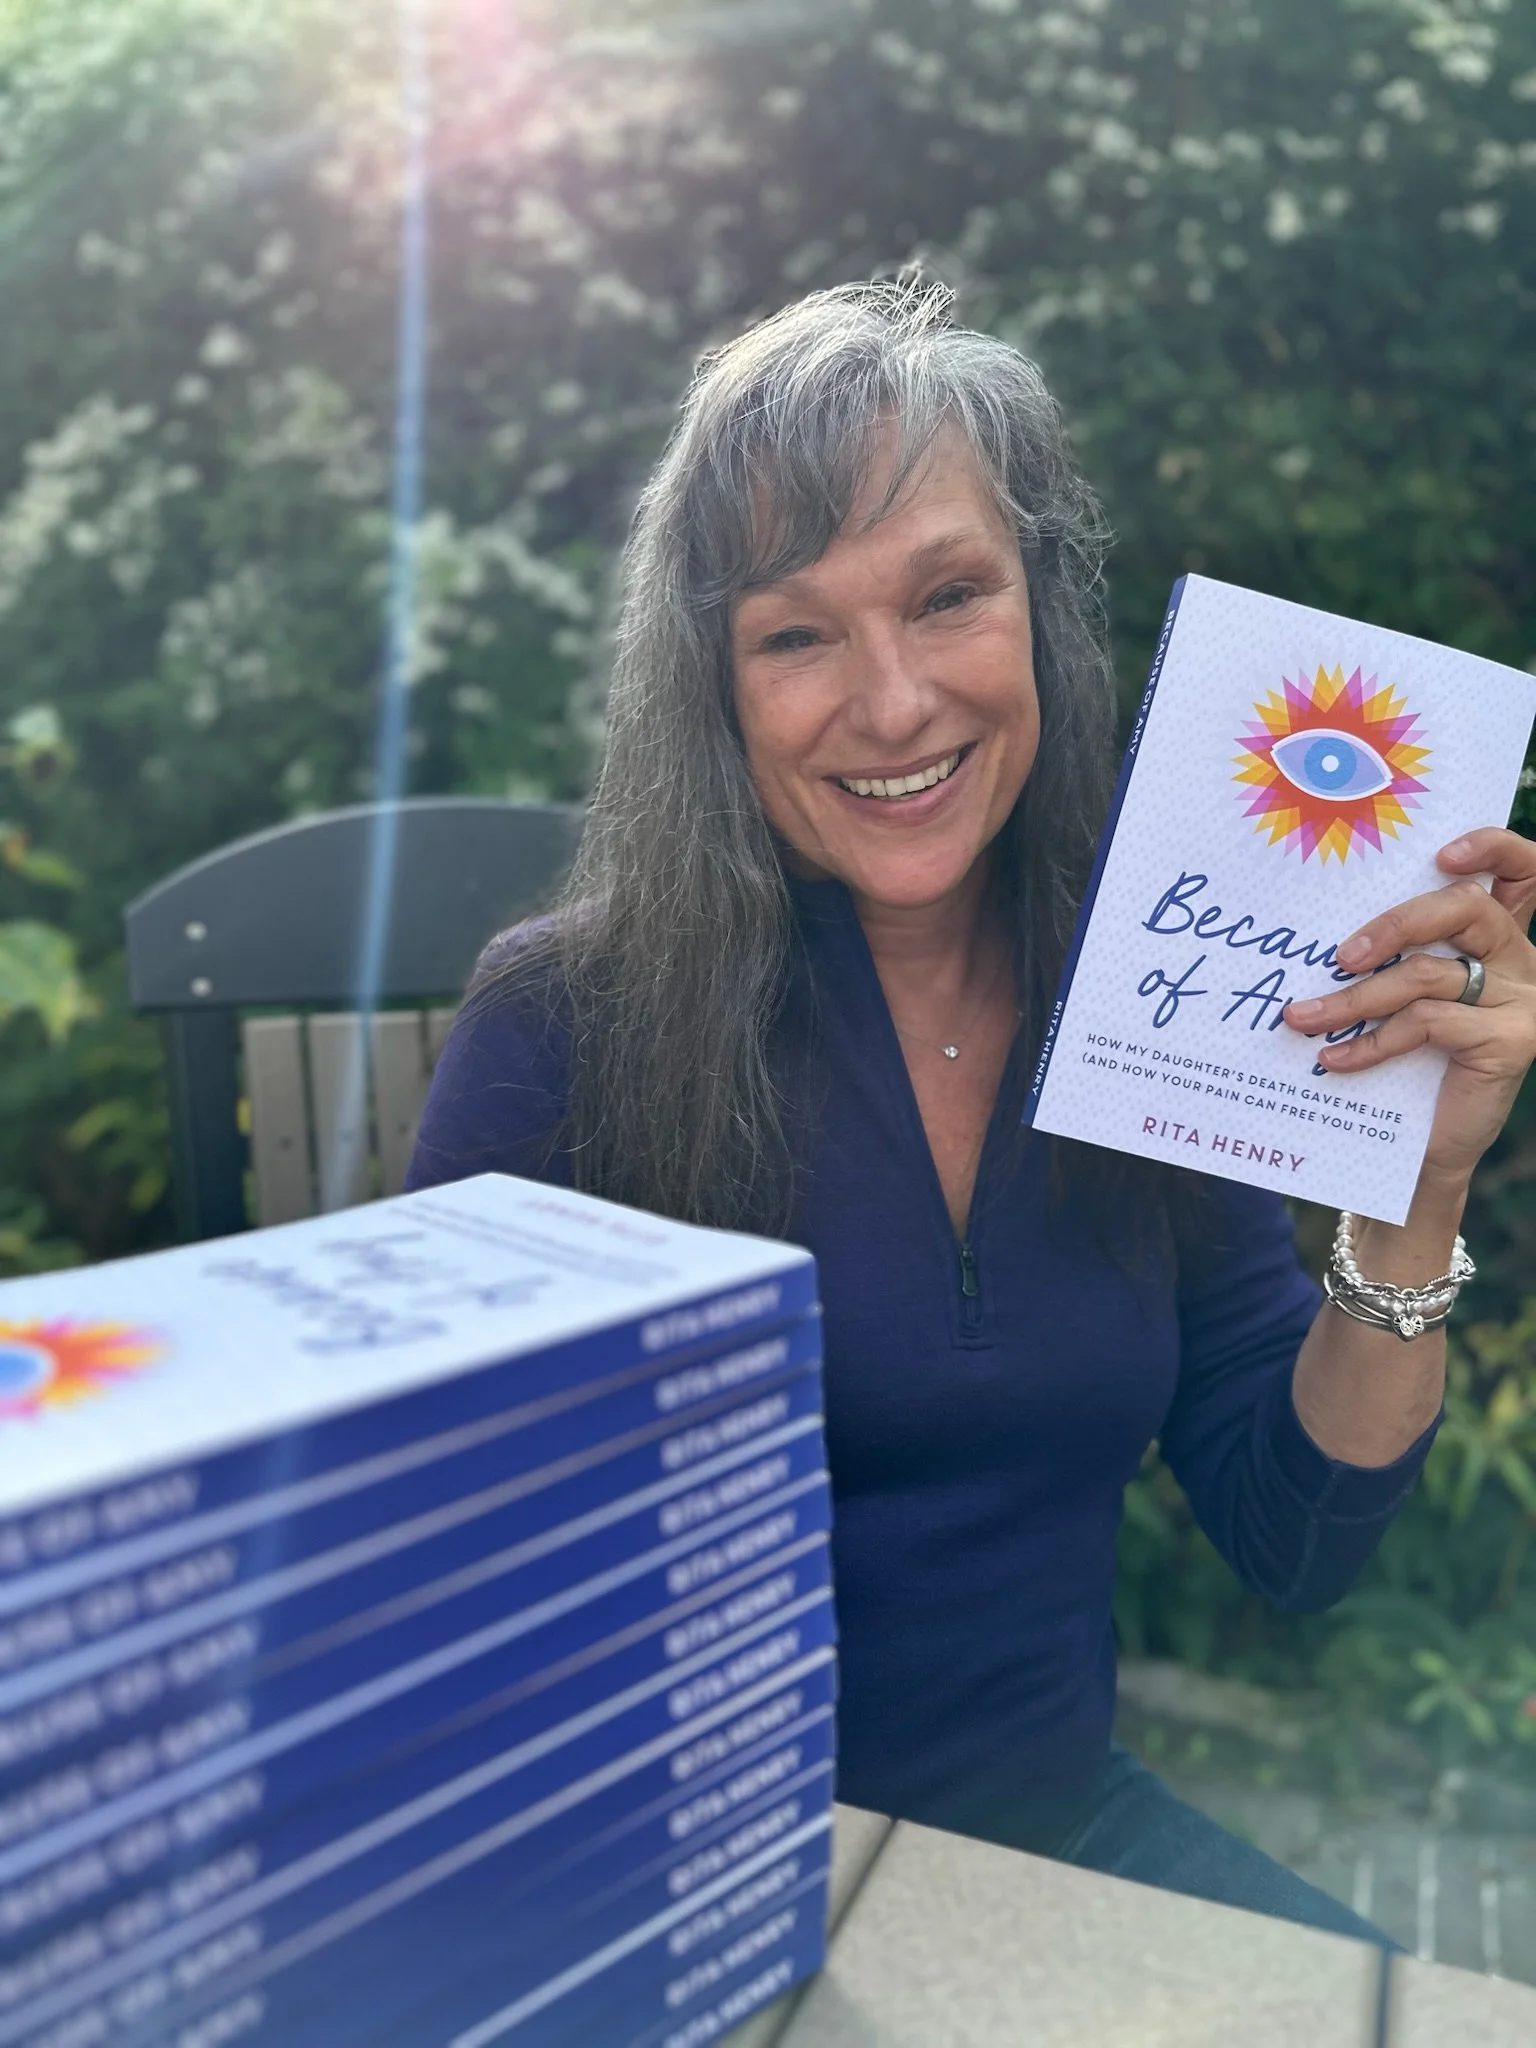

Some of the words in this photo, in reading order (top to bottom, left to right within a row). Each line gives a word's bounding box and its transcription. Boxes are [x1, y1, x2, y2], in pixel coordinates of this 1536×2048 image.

[1148, 609, 1175, 686] BECAUSE
[1142, 689, 1152, 713] OF
[1130, 717, 1144, 755] AMY
[1141, 871, 1401, 981] Becau
[1047, 1000, 1063, 1037] RITA
[1137, 954, 1208, 1029] of
[1032, 1041, 1052, 1096] HENRY
[1082, 1051, 1118, 1070] (AND
[1121, 1063, 1157, 1080] HOW
[1161, 1072, 1202, 1092] YOUR
[1205, 1084, 1241, 1102] PAIN
[1244, 1095, 1276, 1111] CAN
[1280, 1104, 1317, 1122] FREE
[1321, 1113, 1353, 1131] YOU
[1358, 1124, 1396, 1144] TOO)
[1086, 1033, 1122, 1050] HOW
[1125, 1043, 1149, 1057] MY
[1151, 1050, 1245, 1082] DAUGHTER'S
[1248, 1075, 1297, 1096] DEATH
[1300, 1089, 1342, 1108] GAVE
[1345, 1101, 1367, 1115] ME
[1370, 1107, 1403, 1124] LIFE
[1141, 1115, 1202, 1147] RITA
[1211, 1131, 1306, 1174] HENRY
